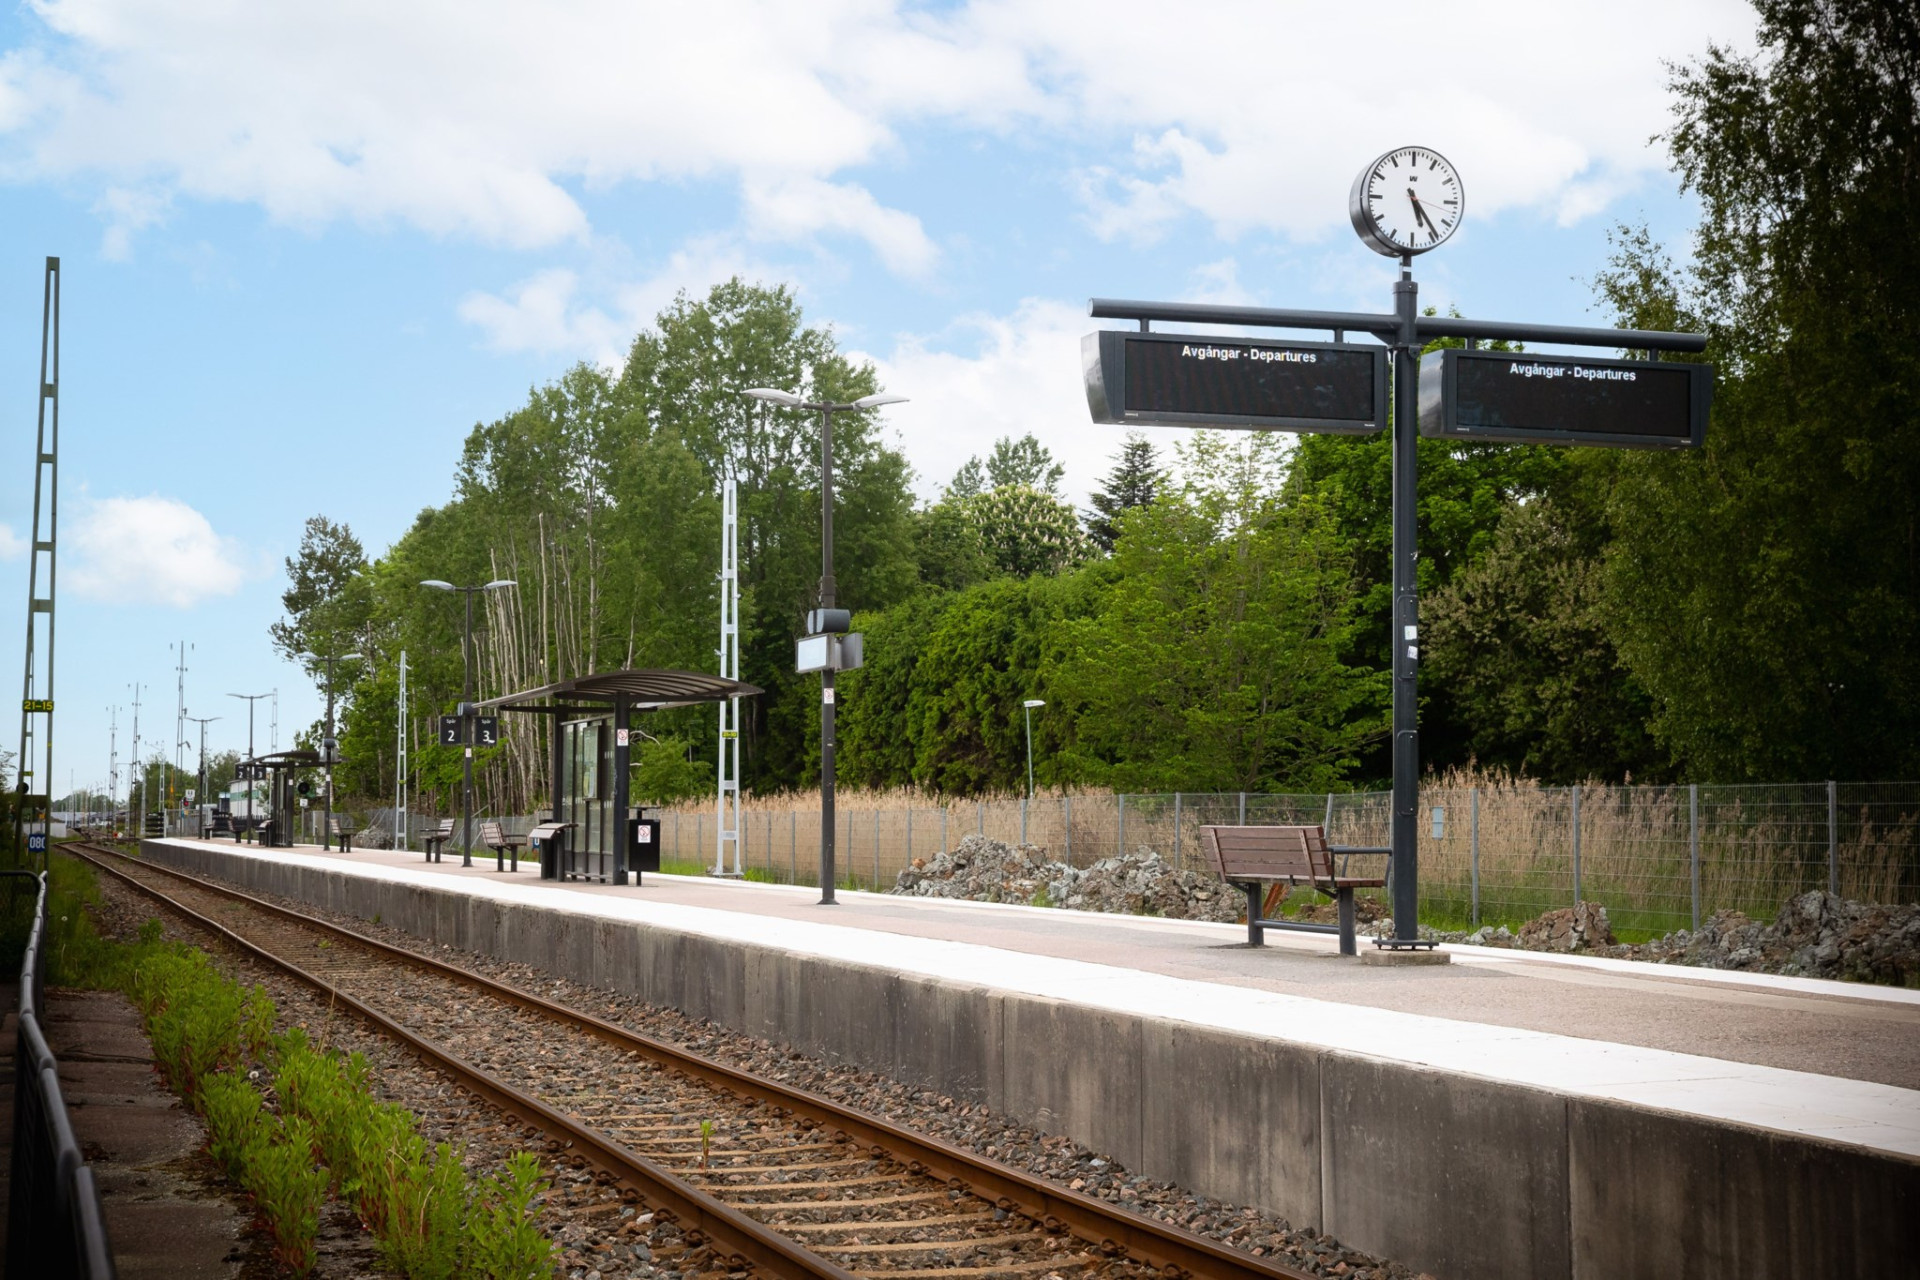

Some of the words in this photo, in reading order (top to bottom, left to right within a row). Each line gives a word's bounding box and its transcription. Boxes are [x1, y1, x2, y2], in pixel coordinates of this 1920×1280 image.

[1182, 345, 1241, 361] Avgångar
[1250, 349, 1317, 363] Departures
[1510, 363, 1565, 378] Avgångar
[1573, 367, 1636, 380] Departures
[23, 700, 53, 710] 21-15
[448, 730, 454, 741] 2
[483, 730, 490, 741] 3
